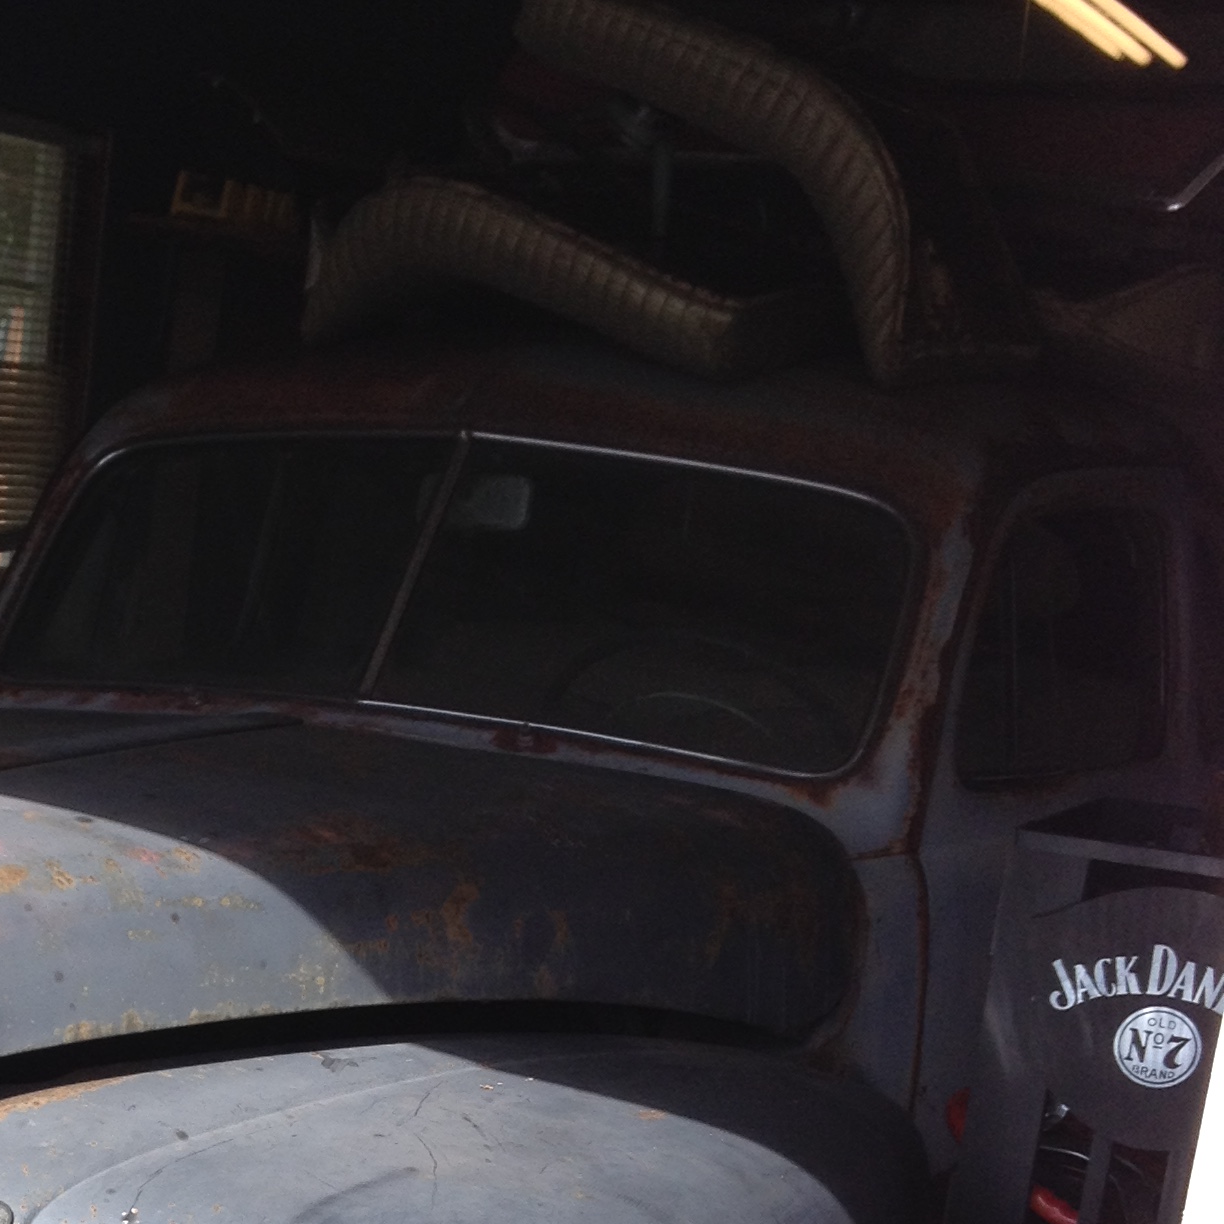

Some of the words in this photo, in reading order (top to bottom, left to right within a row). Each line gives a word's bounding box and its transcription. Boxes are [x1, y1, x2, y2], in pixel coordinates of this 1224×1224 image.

[1049, 955, 1141, 1011] JACK
[1147, 1017, 1176, 1030] OLD
[1131, 1064, 1176, 1080] BRAND
